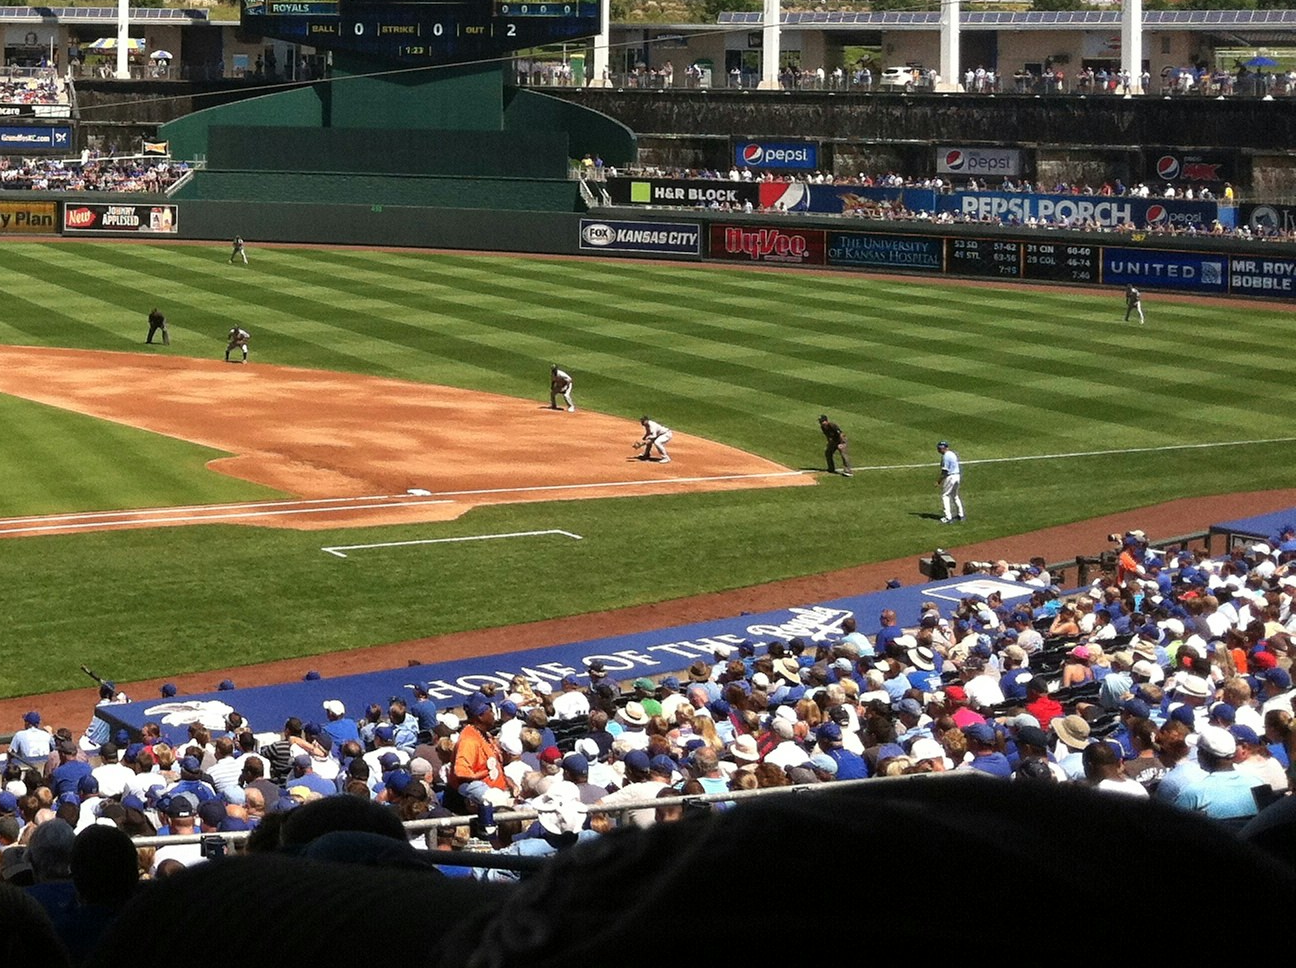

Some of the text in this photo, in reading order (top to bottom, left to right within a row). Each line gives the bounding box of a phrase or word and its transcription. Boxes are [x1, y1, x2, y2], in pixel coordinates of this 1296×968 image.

[272, 4, 310, 12] ROYALS
[312, 23, 517, 36] BALL 0 STRIKE 0 OUT 2
[765, 149, 807, 162] pepsi
[968, 157, 1011, 170] pepsi
[654, 187, 736, 202] H&R BLOCK
[16, 211, 53, 227] Plan
[68, 210, 91, 226] New
[962, 196, 1131, 227] PEPSI PORCH
[1168, 212, 1203, 226] pepsi
[589, 228, 698, 246] FOX KANSAS CITY
[840, 236, 929, 252] THE UNIVERSITY
[828, 248, 940, 265] OF KANSAS HOSPITAL
[966, 252, 981, 260] STL
[1039, 256, 1056, 265] COL
[1111, 260, 1195, 279] UNITED
[1232, 260, 1296, 276] MR. ROY
[1232, 275, 1292, 291] BOBBLE
[405, 661, 578, 701] HOME
[582, 647, 662, 677] OF
[647, 632, 748, 661] THE
